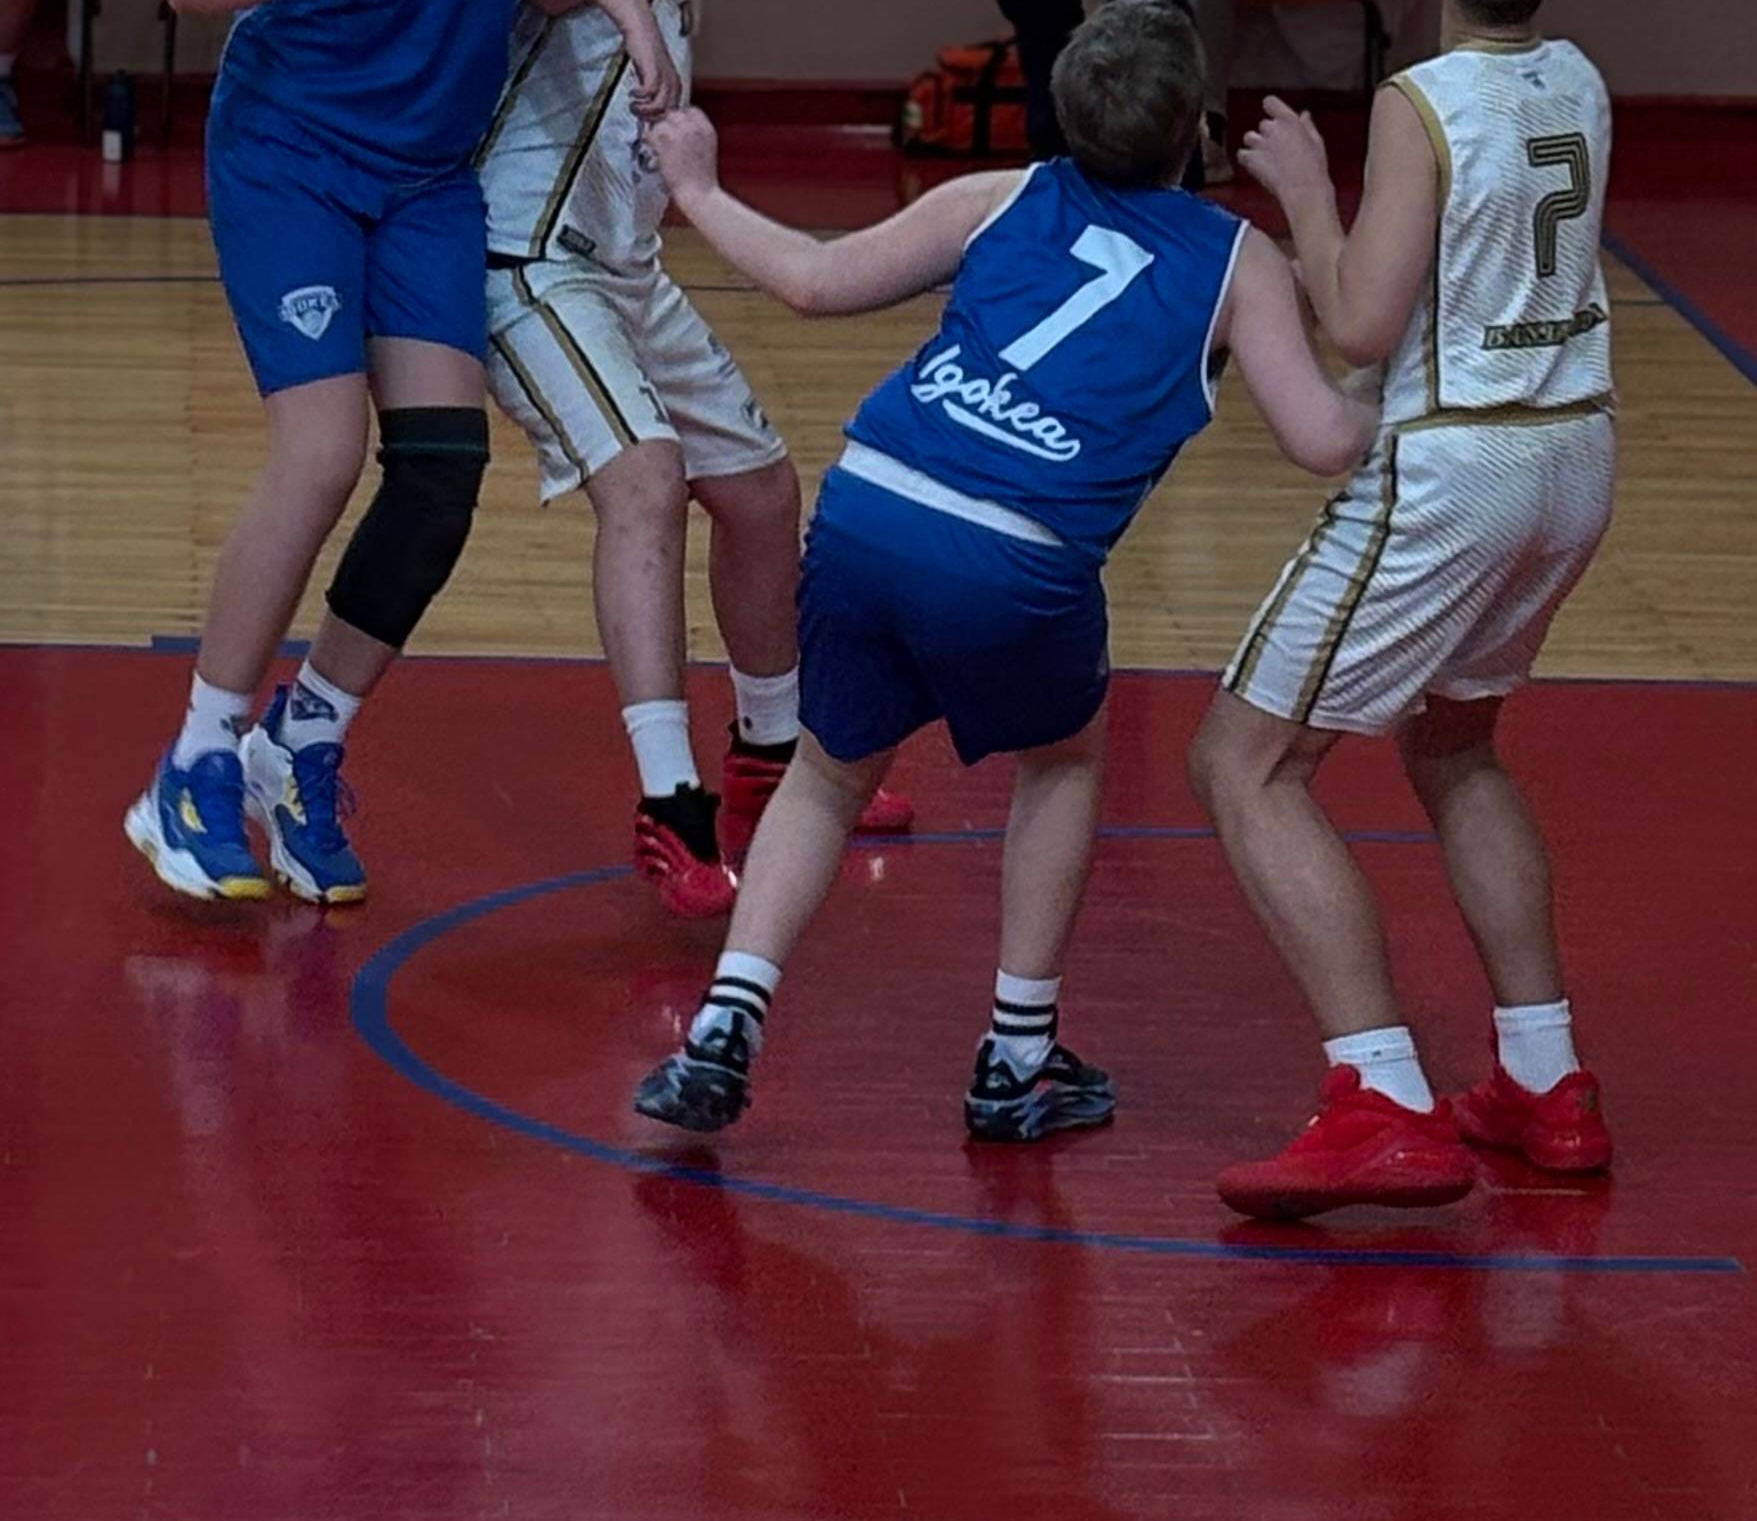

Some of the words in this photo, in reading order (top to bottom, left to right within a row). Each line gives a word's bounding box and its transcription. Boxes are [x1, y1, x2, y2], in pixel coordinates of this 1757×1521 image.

[1527, 131, 1591, 279] 7
[998, 223, 1155, 372] 7
[910, 343, 1081, 463] Igokea
